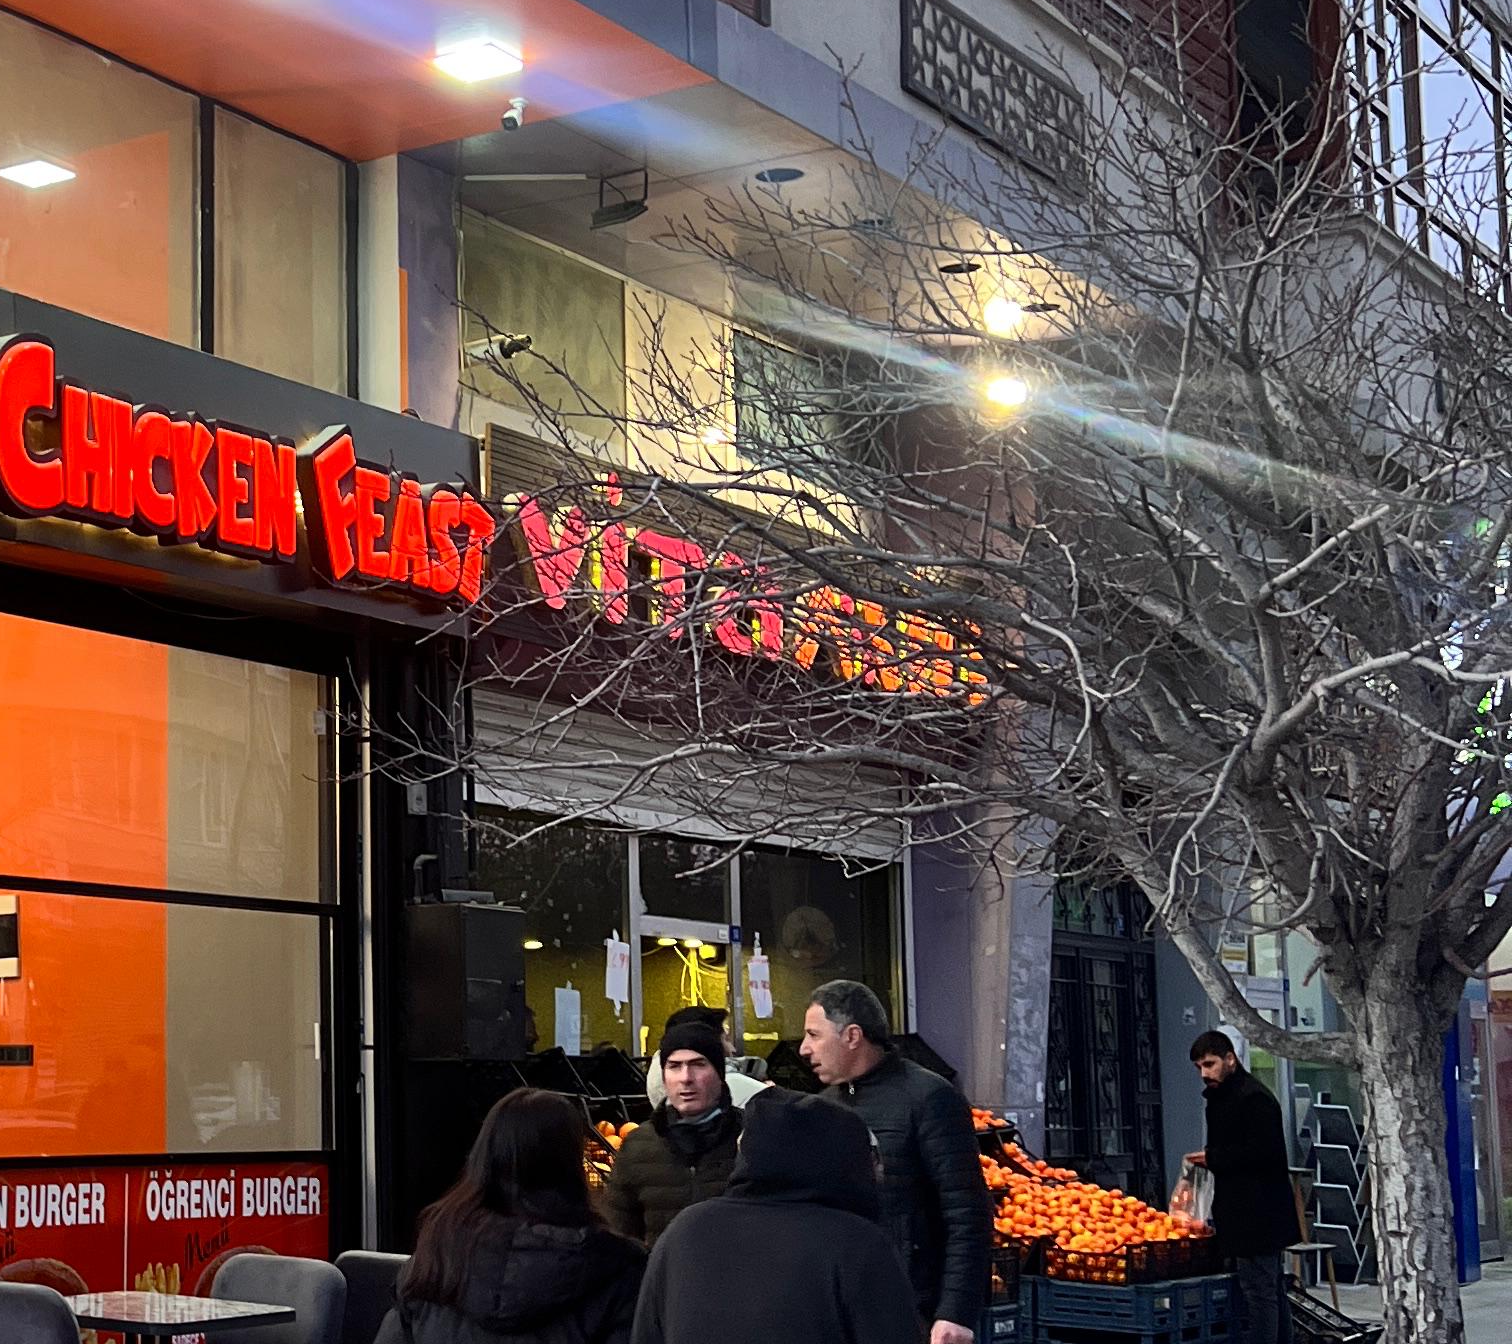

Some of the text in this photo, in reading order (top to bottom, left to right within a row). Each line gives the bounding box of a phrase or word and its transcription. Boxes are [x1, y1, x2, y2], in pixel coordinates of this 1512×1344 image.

[314, 432, 497, 605] FEAST
[15, 1182, 106, 1228] BURGER
[145, 1169, 321, 1222] ÖĞRENCİ BURGER
